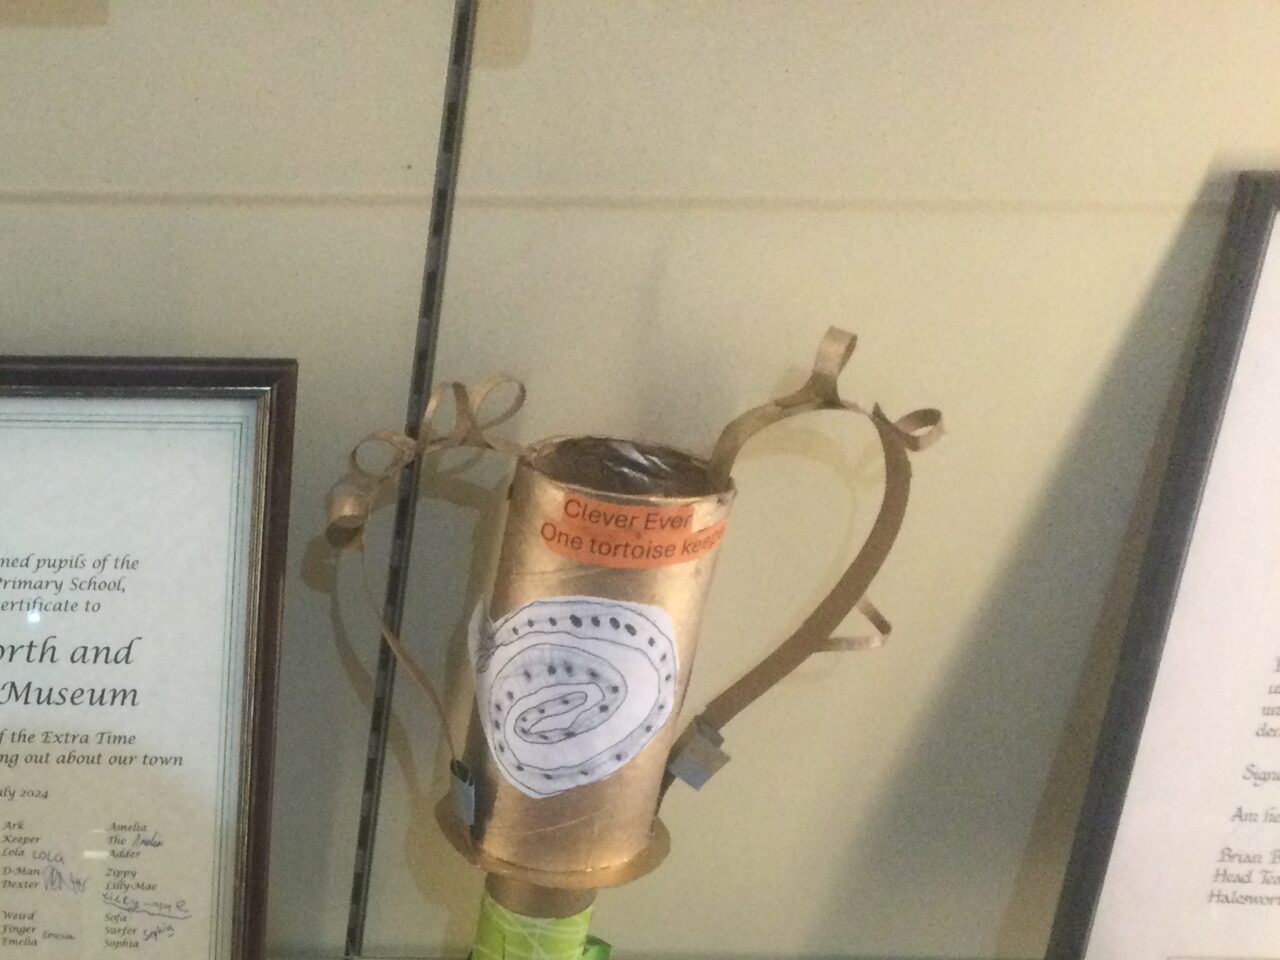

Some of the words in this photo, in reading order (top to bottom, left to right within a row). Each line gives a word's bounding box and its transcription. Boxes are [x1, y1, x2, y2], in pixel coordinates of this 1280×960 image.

[565, 499, 639, 529] Clever
[644, 511, 692, 531] Ever
[540, 522, 583, 551] One
[591, 537, 677, 560] tortoise
[32, 553, 86, 574] pupils
[91, 554, 111, 574] of
[114, 554, 139, 570] the
[69, 576, 126, 593] School,
[84, 600, 101, 612] to
[69, 636, 143, 665] and
[10, 729, 36, 744] the
[41, 731, 89, 745] Extra
[95, 732, 136, 745] Time
[24, 752, 50, 765] out
[56, 750, 103, 765] about
[108, 756, 137, 766] our
[142, 754, 183, 767] town
[19, 790, 49, 800] 2024
[3, 821, 24, 830] Ark
[107, 822, 147, 832] Amelia
[1, 836, 40, 846] Keeper
[108, 836, 127, 846] The
[2, 849, 25, 858] Lola
[110, 850, 142, 859] Adder
[1217, 846, 1263, 864] Brian
[2, 867, 40, 876] D-Man
[105, 868, 137, 880] Zippy
[1213, 867, 1252, 884] Head
[1, 880, 39, 889] Dexter
[3, 910, 35, 921] Weird
[105, 912, 127, 923] Sofa
[104, 926, 137, 937] Surfer
[104, 940, 139, 950] Sophia
